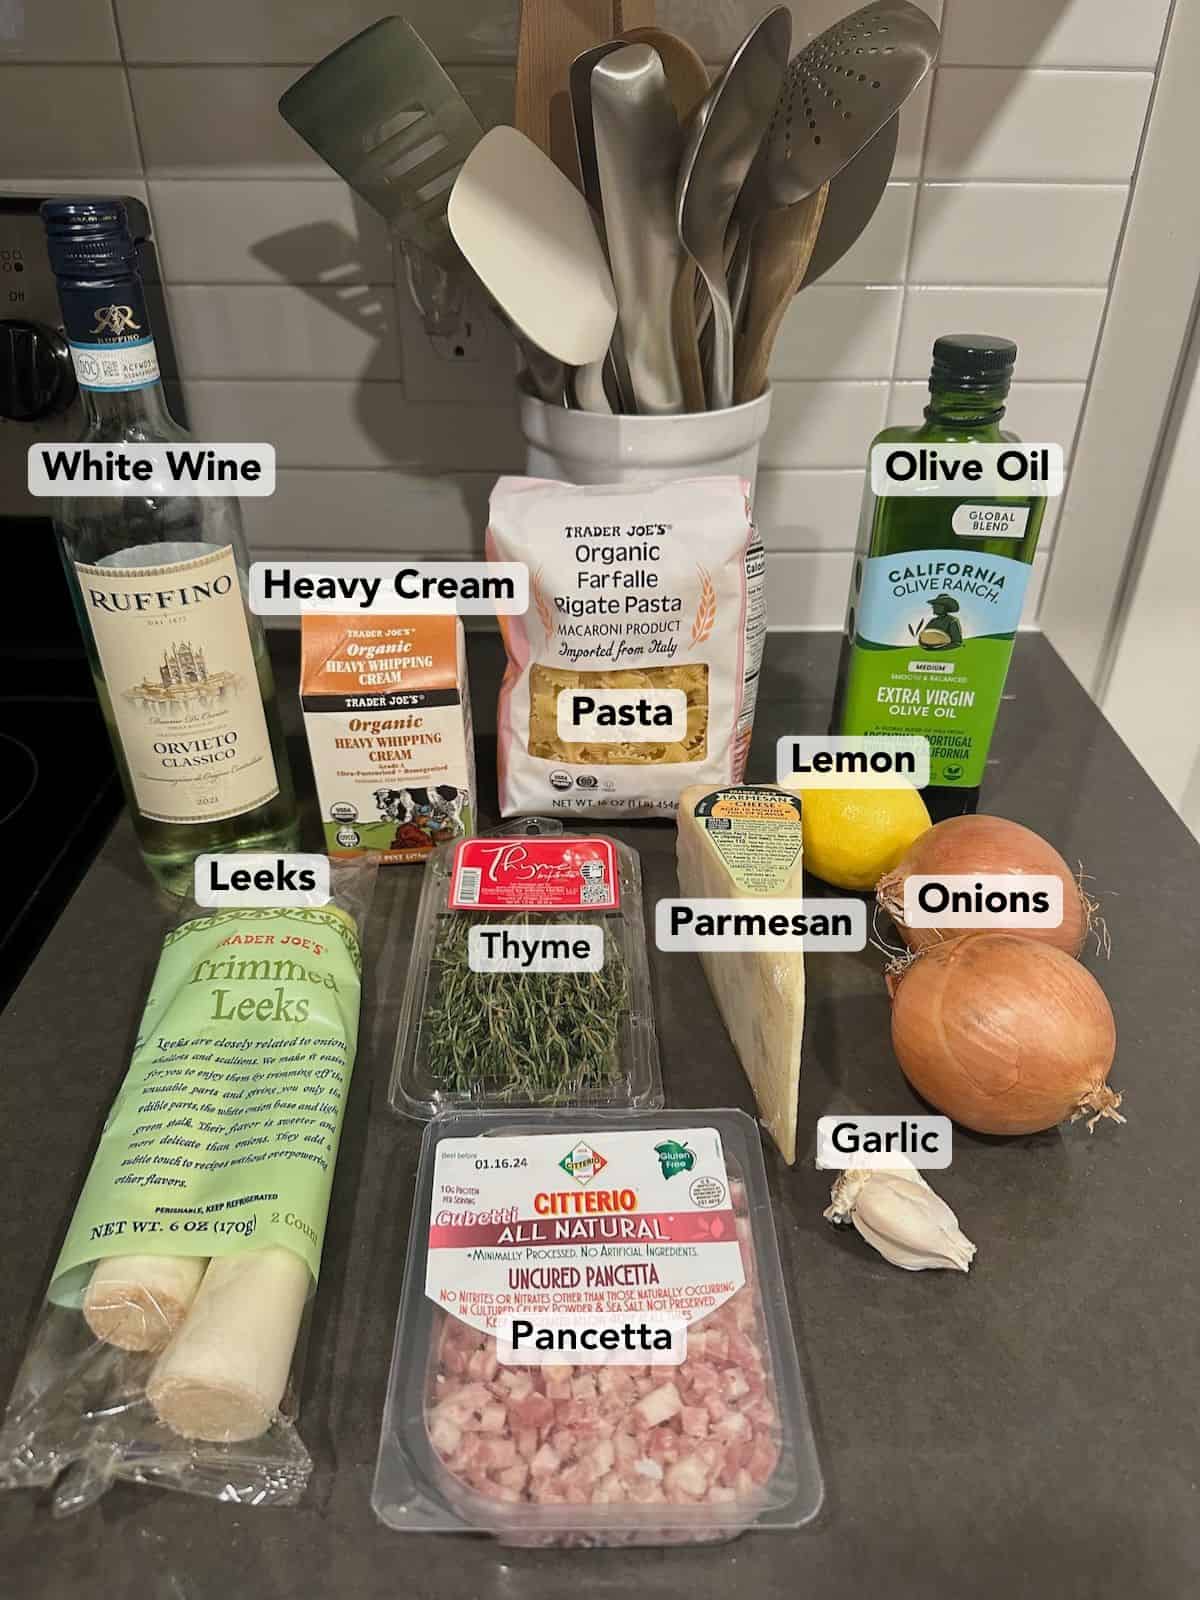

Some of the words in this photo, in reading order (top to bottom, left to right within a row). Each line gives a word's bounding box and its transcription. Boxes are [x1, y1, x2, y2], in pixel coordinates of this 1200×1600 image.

[969, 511, 1016, 522] GLOBAL
[565, 526, 621, 538] TRADER
[627, 524, 667, 537] JOE'S
[972, 521, 1009, 532] BLEND
[576, 542, 660, 565] Organic
[578, 570, 659, 589] Farfalle
[888, 563, 1006, 588] CALIFORNIA
[89, 575, 232, 612] RUFFINO
[893, 578, 939, 597] OLIVE
[554, 596, 620, 617] Rigate
[625, 596, 682, 613] Pasta
[347, 630, 382, 638] TRADER
[557, 624, 623, 637] MACARONI
[626, 620, 681, 635] PRODUCT
[347, 640, 412, 659] Organic
[558, 642, 613, 662] Imported
[615, 640, 644, 661] from
[649, 638, 678, 658] Italy
[326, 659, 366, 673] HEAVY
[368, 656, 433, 673] WHIPPING
[915, 663, 946, 671] MEDIUM
[359, 671, 402, 686] CREAM
[345, 697, 387, 707] TRADER
[389, 695, 419, 705] JOE'S
[877, 687, 921, 704] EXTRA
[926, 689, 976, 707] VIRGIN
[889, 705, 929, 717] OLIVE
[934, 707, 957, 718] OIL
[349, 715, 423, 734] Organic
[153, 731, 238, 754] ORVIETO
[335, 738, 376, 749] HEAVY
[376, 733, 442, 748] WHIPPING
[161, 748, 236, 768] CLASSICO
[369, 749, 412, 762] CREAM
[552, 799, 572, 808] NET
[610, 799, 625, 807] OZ
[723, 794, 789, 803] PARMESAN
[481, 842, 570, 882] Thyme
[280, 934, 322, 956] JOE'S
[211, 988, 309, 1023] Leeks
[158, 1037, 190, 1051] Leeks
[191, 1038, 213, 1046] are
[214, 1037, 254, 1052] closely
[255, 1037, 299, 1048] related
[299, 1038, 312, 1046] to
[192, 1053, 213, 1061] and
[197, 1071, 224, 1081] enjoy
[189, 1086, 219, 1097] parts
[223, 1089, 244, 1099] and
[303, 1085, 325, 1096] only
[200, 1103, 216, 1112] the
[273, 1099, 297, 1109] base
[298, 1102, 320, 1111] and
[198, 1121, 226, 1133] Their
[277, 1117, 318, 1126] sweeter
[159, 1135, 201, 1148] delicate
[206, 1141, 230, 1151] than
[304, 1134, 325, 1145] add
[121, 1154, 152, 1167] subtle
[153, 1154, 183, 1167] touch
[182, 1159, 193, 1168] to
[194, 1160, 230, 1172] recipes
[475, 1158, 528, 1170] 01.16.24
[566, 1157, 600, 1169] CITTERIO
[660, 1151, 690, 1161] Gluten
[666, 1160, 687, 1168] Free
[114, 1173, 144, 1185] other
[140, 1173, 187, 1188] flavors.
[155, 1205, 204, 1214] PERISHABLE,
[205, 1203, 225, 1213] KEEP
[226, 1193, 279, 1209] REFRIGERATED
[534, 1189, 638, 1215] CITTERIO
[271, 1213, 280, 1224] 2
[90, 1220, 127, 1241] NET
[132, 1221, 164, 1233] WT.
[170, 1222, 180, 1233] 6
[184, 1221, 209, 1233] OZ
[214, 1213, 257, 1237] (170g)
[497, 1224, 547, 1244] ALL
[508, 1267, 580, 1289] UNCURED
[586, 1263, 660, 1288] PANCETTA
